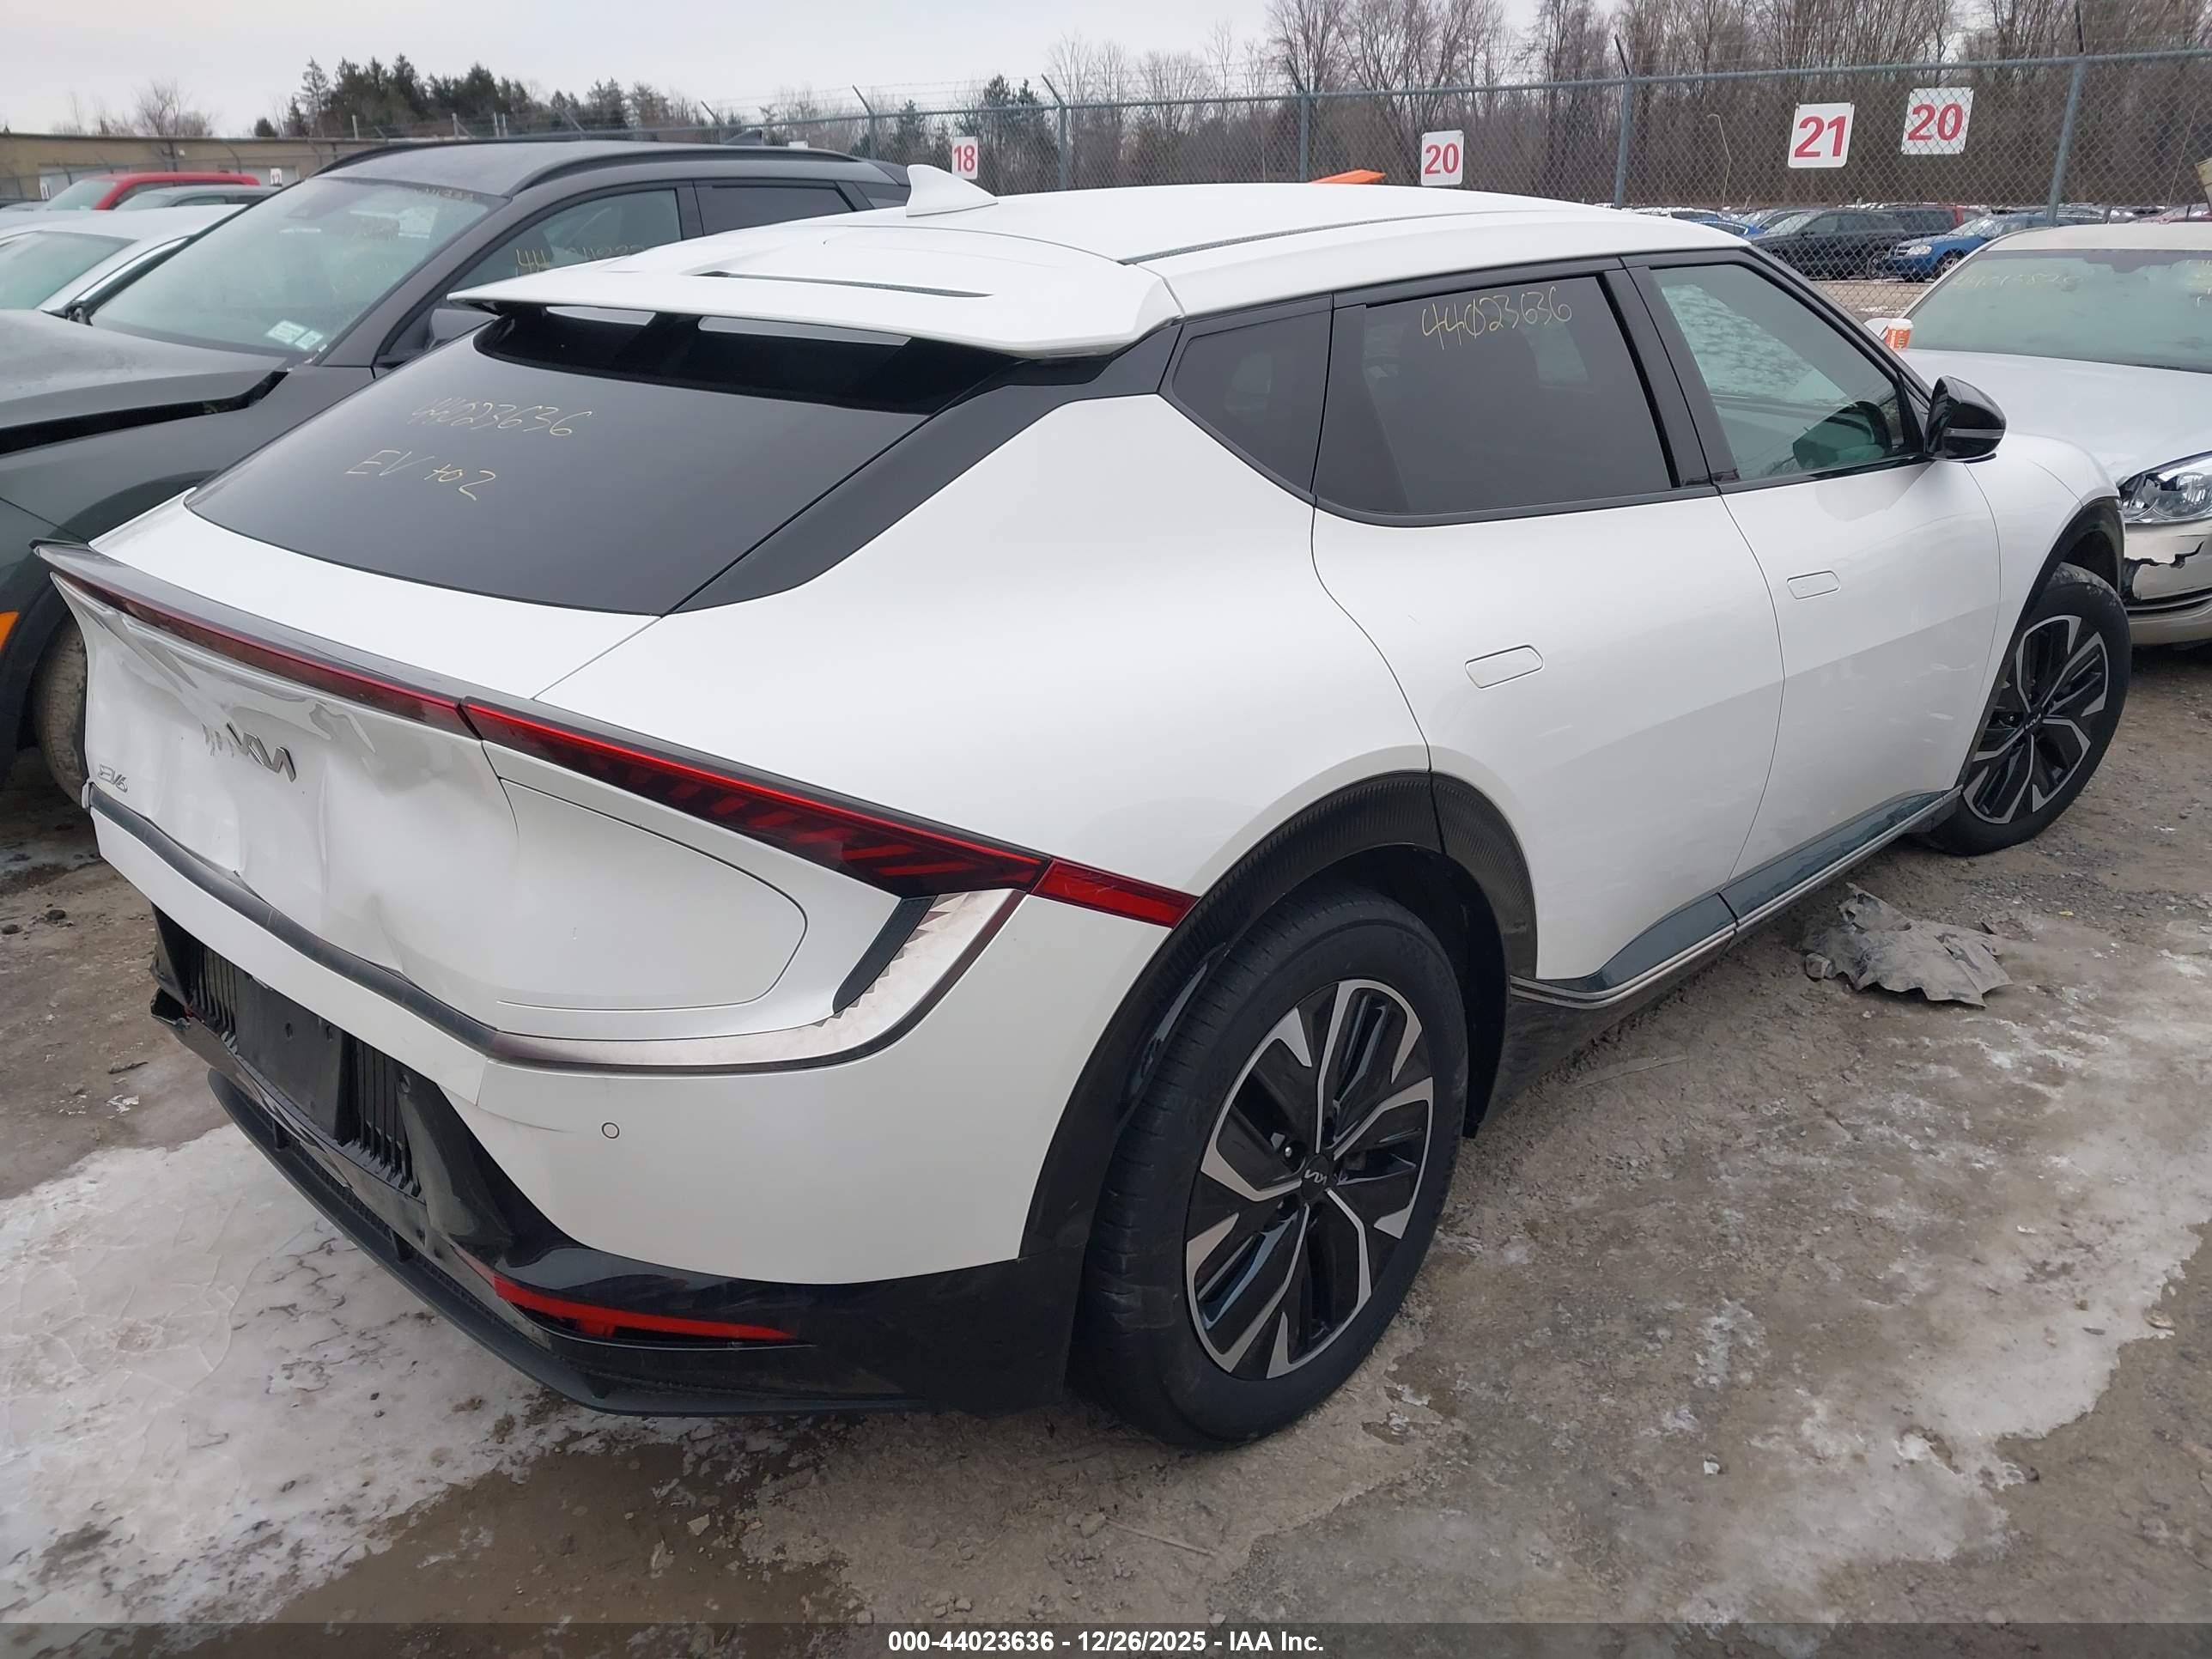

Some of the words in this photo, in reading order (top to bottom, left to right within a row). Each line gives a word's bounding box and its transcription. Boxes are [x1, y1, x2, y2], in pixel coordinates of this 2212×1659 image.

[1794, 116, 1847, 158] 21
[1907, 103, 1964, 141] 20
[954, 144, 975, 173] 18
[1425, 143, 1460, 175] 20
[1421, 286, 1572, 350] 44023636
[344, 449, 435, 477] EV
